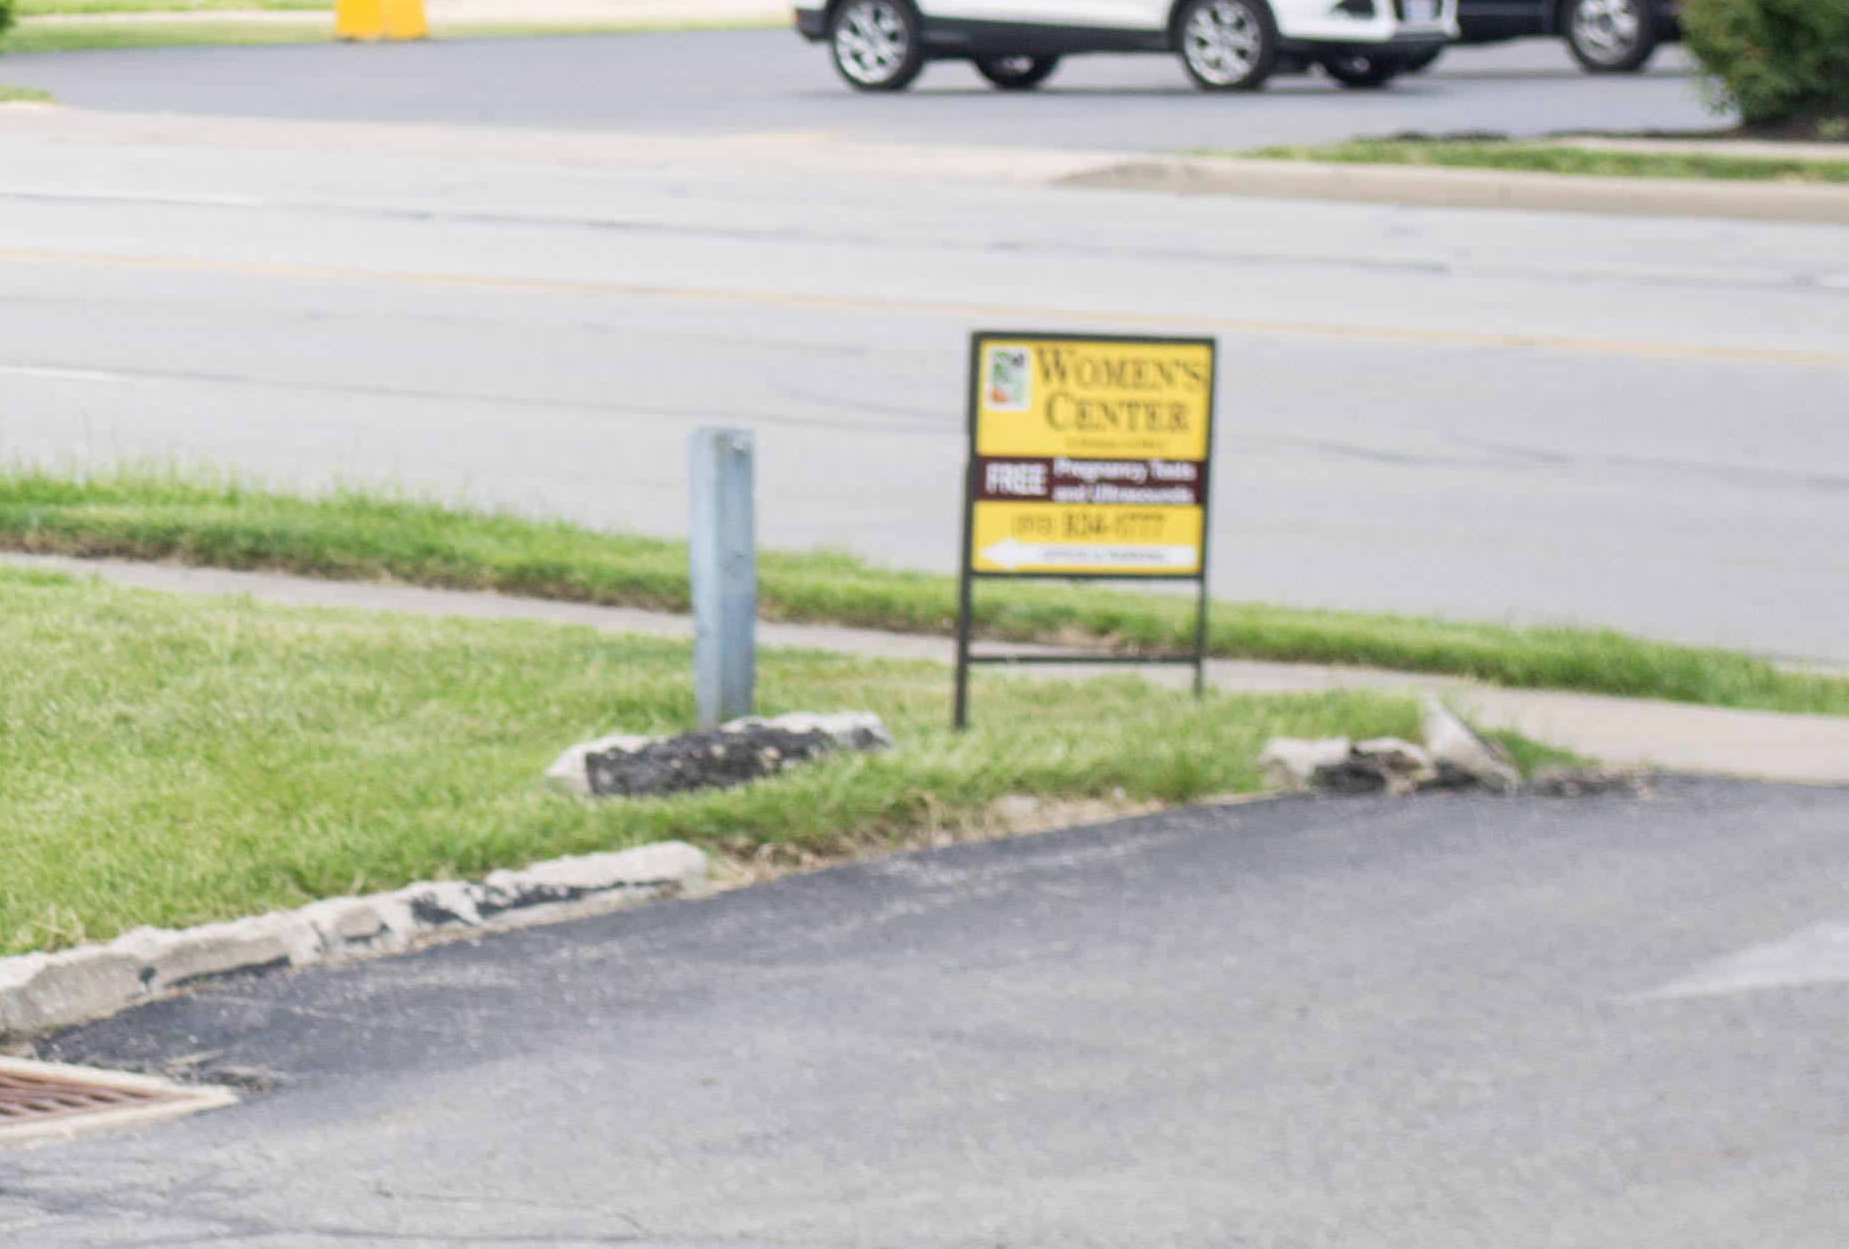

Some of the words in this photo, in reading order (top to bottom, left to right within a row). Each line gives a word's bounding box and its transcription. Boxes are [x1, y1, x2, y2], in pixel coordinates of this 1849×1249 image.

[1034, 346, 1208, 391] WOMEN'S
[1045, 390, 1189, 432] CENTER
[985, 461, 1048, 496] FREE
[1052, 456, 1148, 483] Pregnancy
[1052, 483, 1087, 504] and
